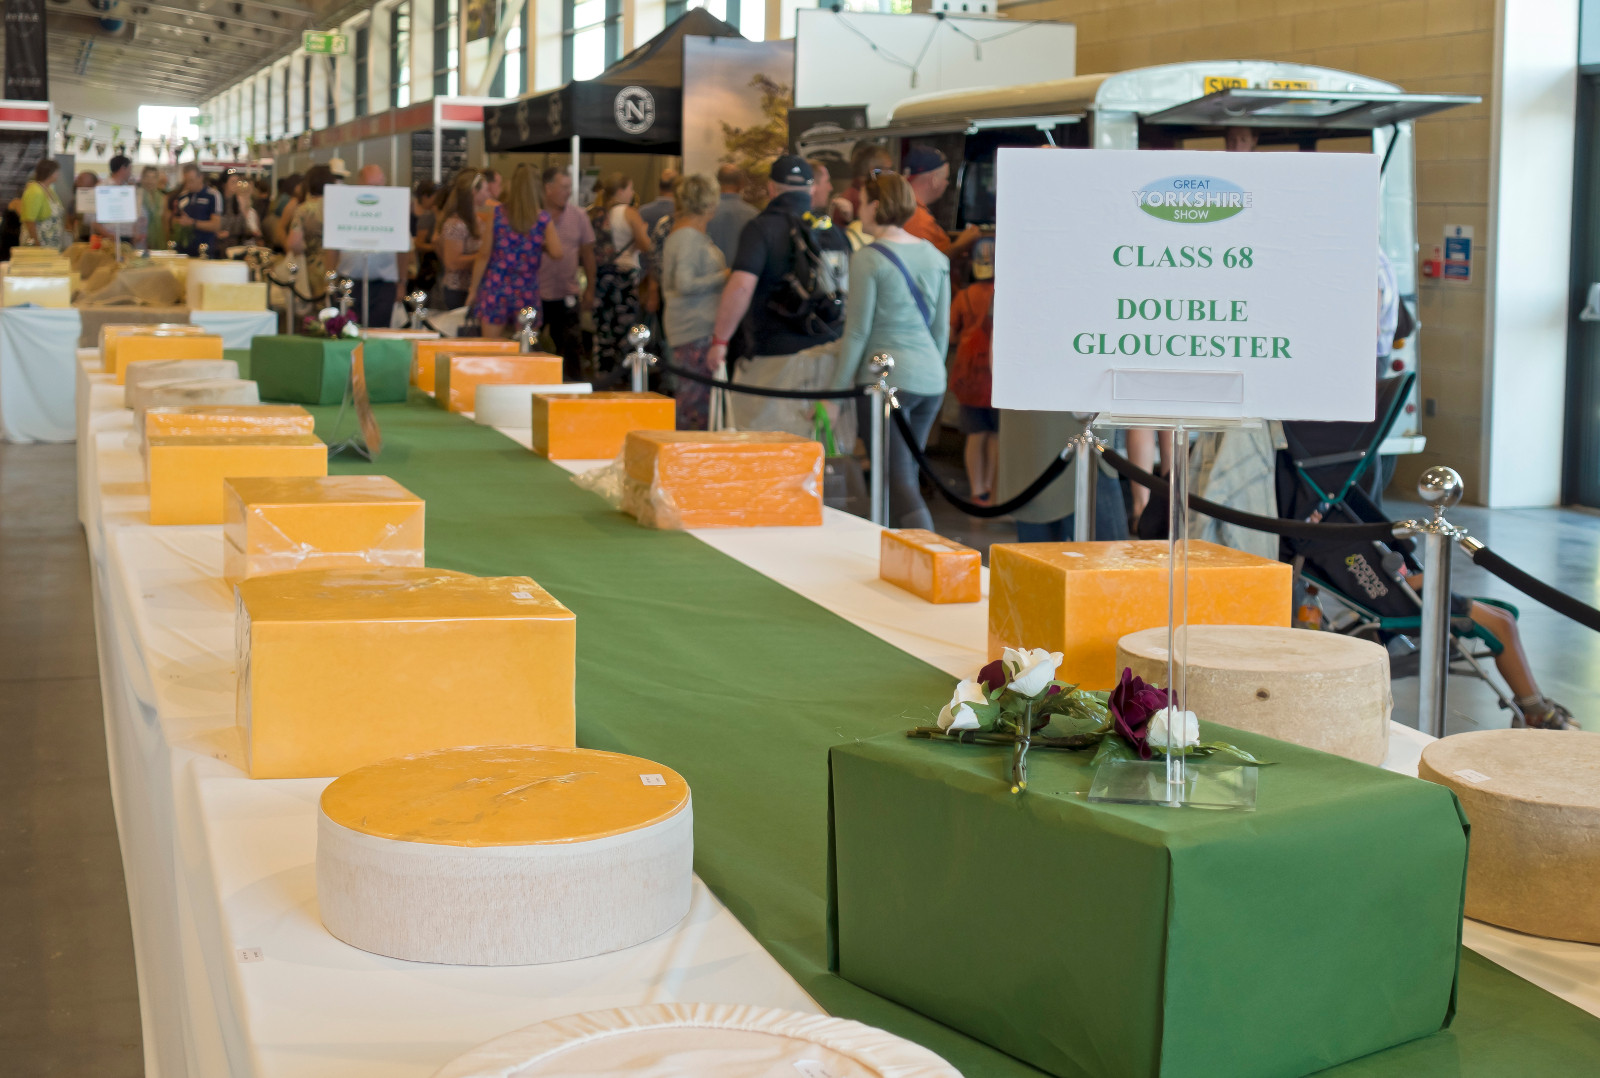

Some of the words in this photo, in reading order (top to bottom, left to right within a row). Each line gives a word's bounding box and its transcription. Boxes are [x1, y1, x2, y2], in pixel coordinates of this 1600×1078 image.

[624, 99, 647, 121] N
[1173, 179, 1210, 190] GREAT
[1131, 190, 1253, 209] YORKSHIRE
[1173, 209, 1209, 220] SHOW
[1112, 244, 1214, 269] CLASS
[1222, 246, 1254, 269] 68
[1115, 298, 1249, 323] DOUBLE
[1072, 332, 1293, 360] GLOUCESTER
[1348, 562, 1377, 599] papas
[1355, 553, 1388, 597] mamas
